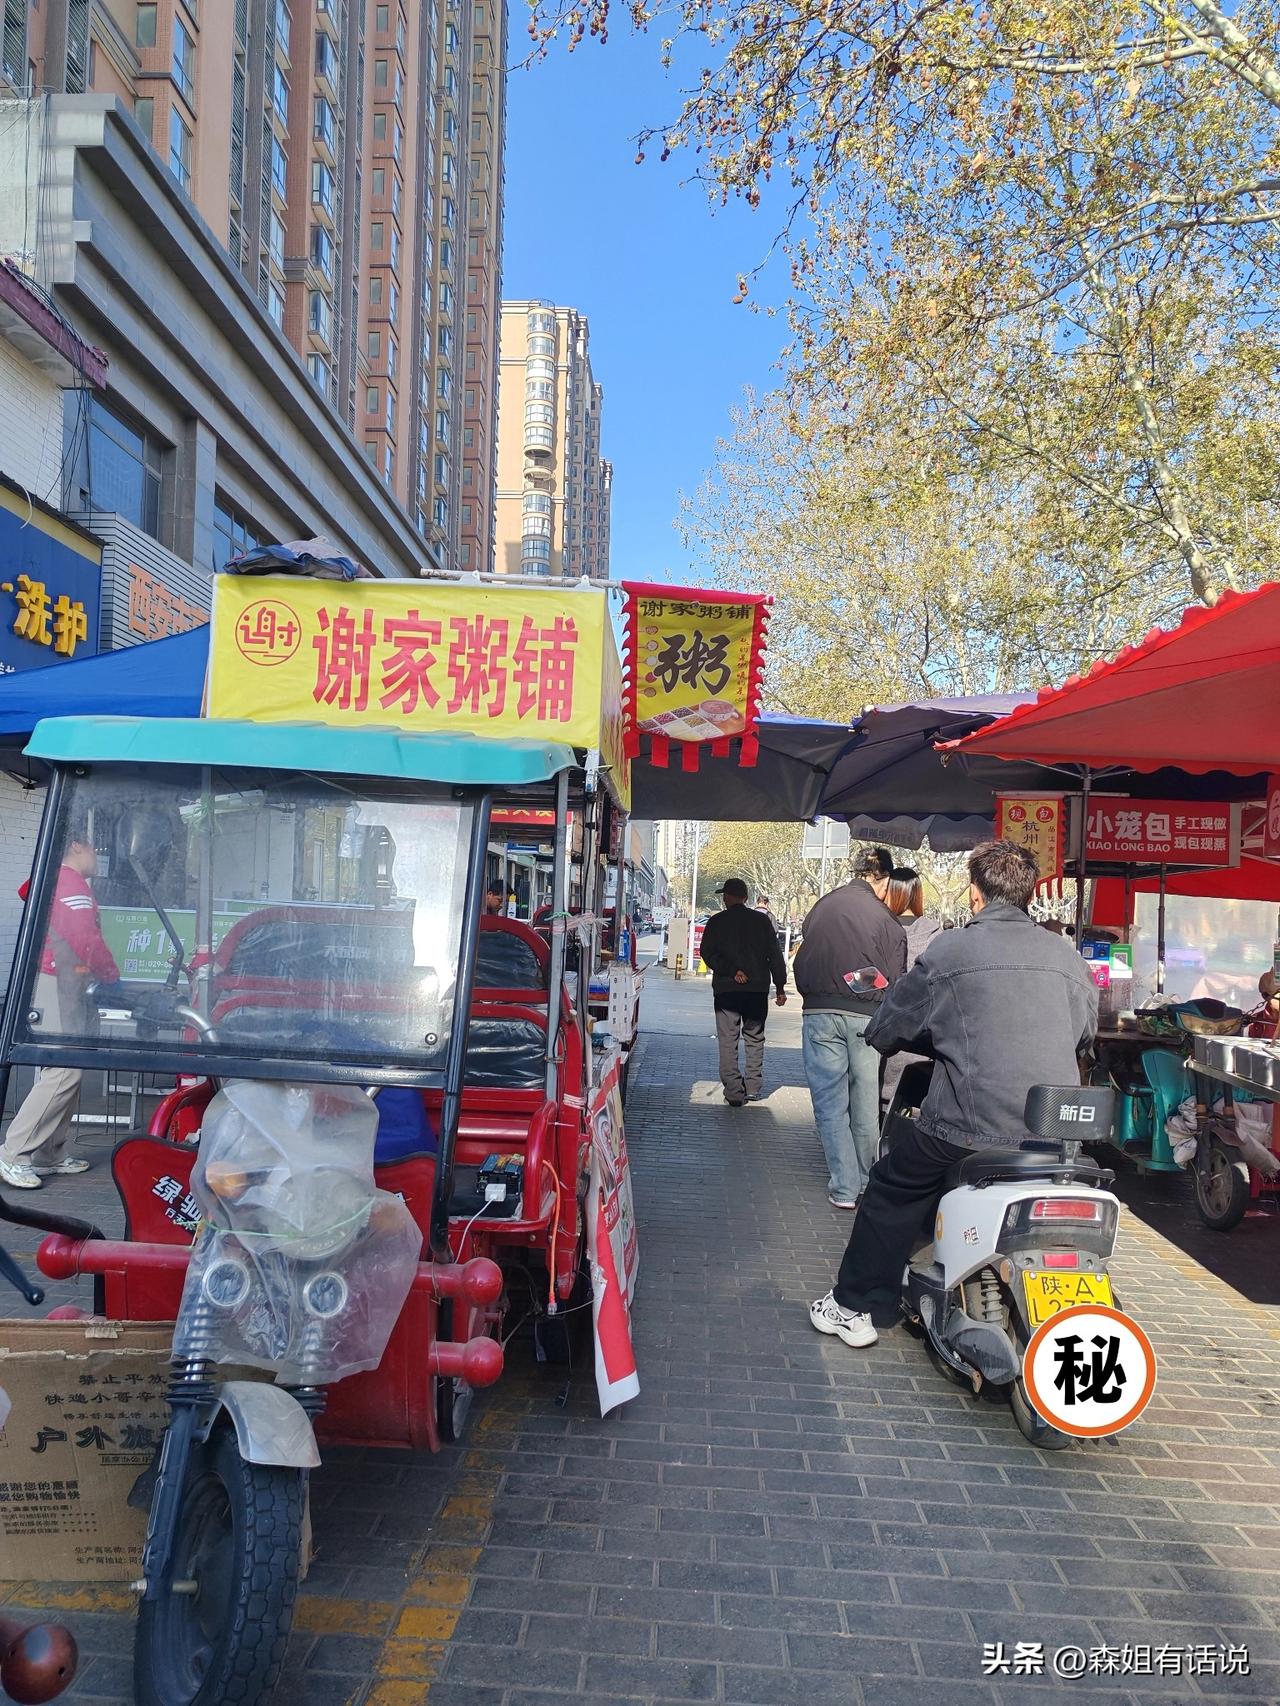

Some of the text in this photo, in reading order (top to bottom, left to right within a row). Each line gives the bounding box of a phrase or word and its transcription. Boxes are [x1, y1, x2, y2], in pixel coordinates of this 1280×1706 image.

[640, 600, 752, 619] 谢家粥铺
[312, 606, 579, 722] 谢家粥铺
[654, 630, 731, 695] 粥
[1086, 810, 1171, 841] 小笼包
[1175, 815, 1227, 831] 手工现做
[1086, 840, 1171, 853] XIAO LONG BAO
[1174, 836, 1227, 851] 现包现蒸
[1060, 1104, 1096, 1122] 新日
[79, 1374, 168, 1386] 禁止平放
